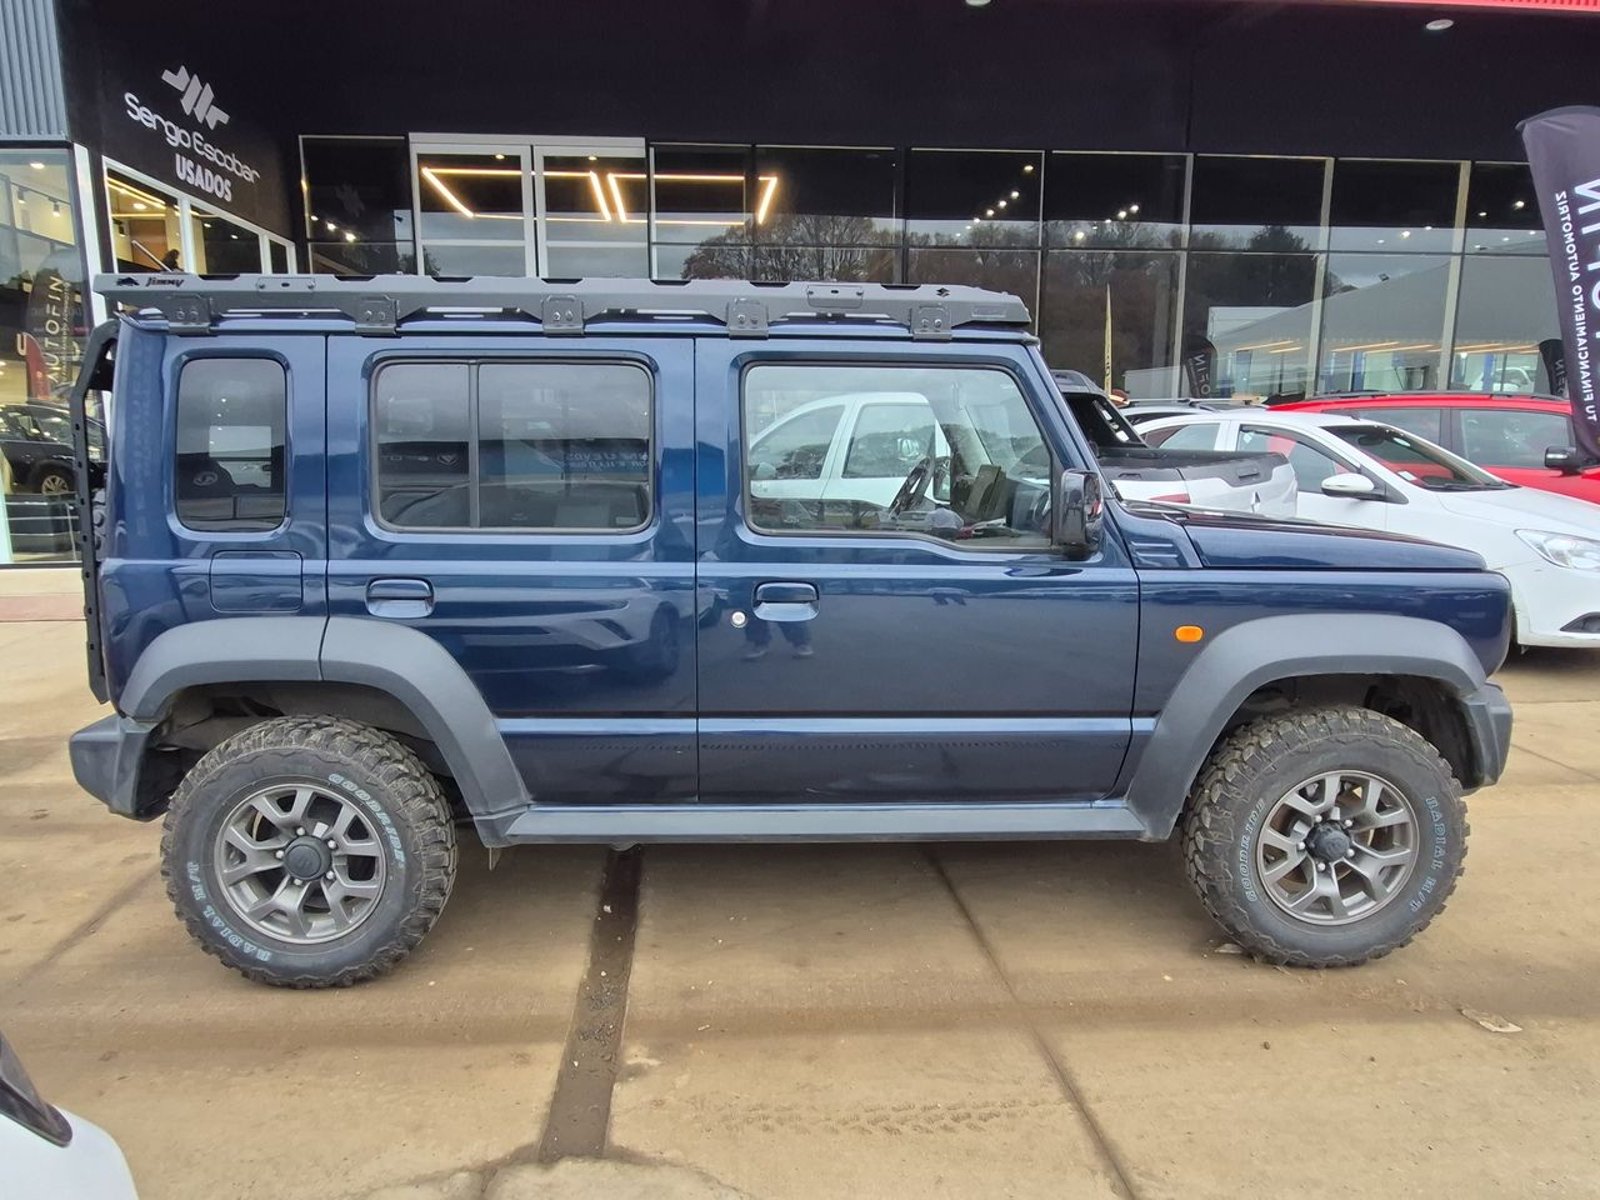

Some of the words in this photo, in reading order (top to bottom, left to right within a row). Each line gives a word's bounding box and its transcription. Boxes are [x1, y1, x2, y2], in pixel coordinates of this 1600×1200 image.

[175, 153, 232, 202] USADOS
[192, 131, 261, 184] Escobar
[44, 276, 63, 383] AUTOFIN
[328, 773, 406, 862] GOODRIDE
[1425, 796, 1447, 870] RADIAL
[203, 904, 272, 962] RADIAL
